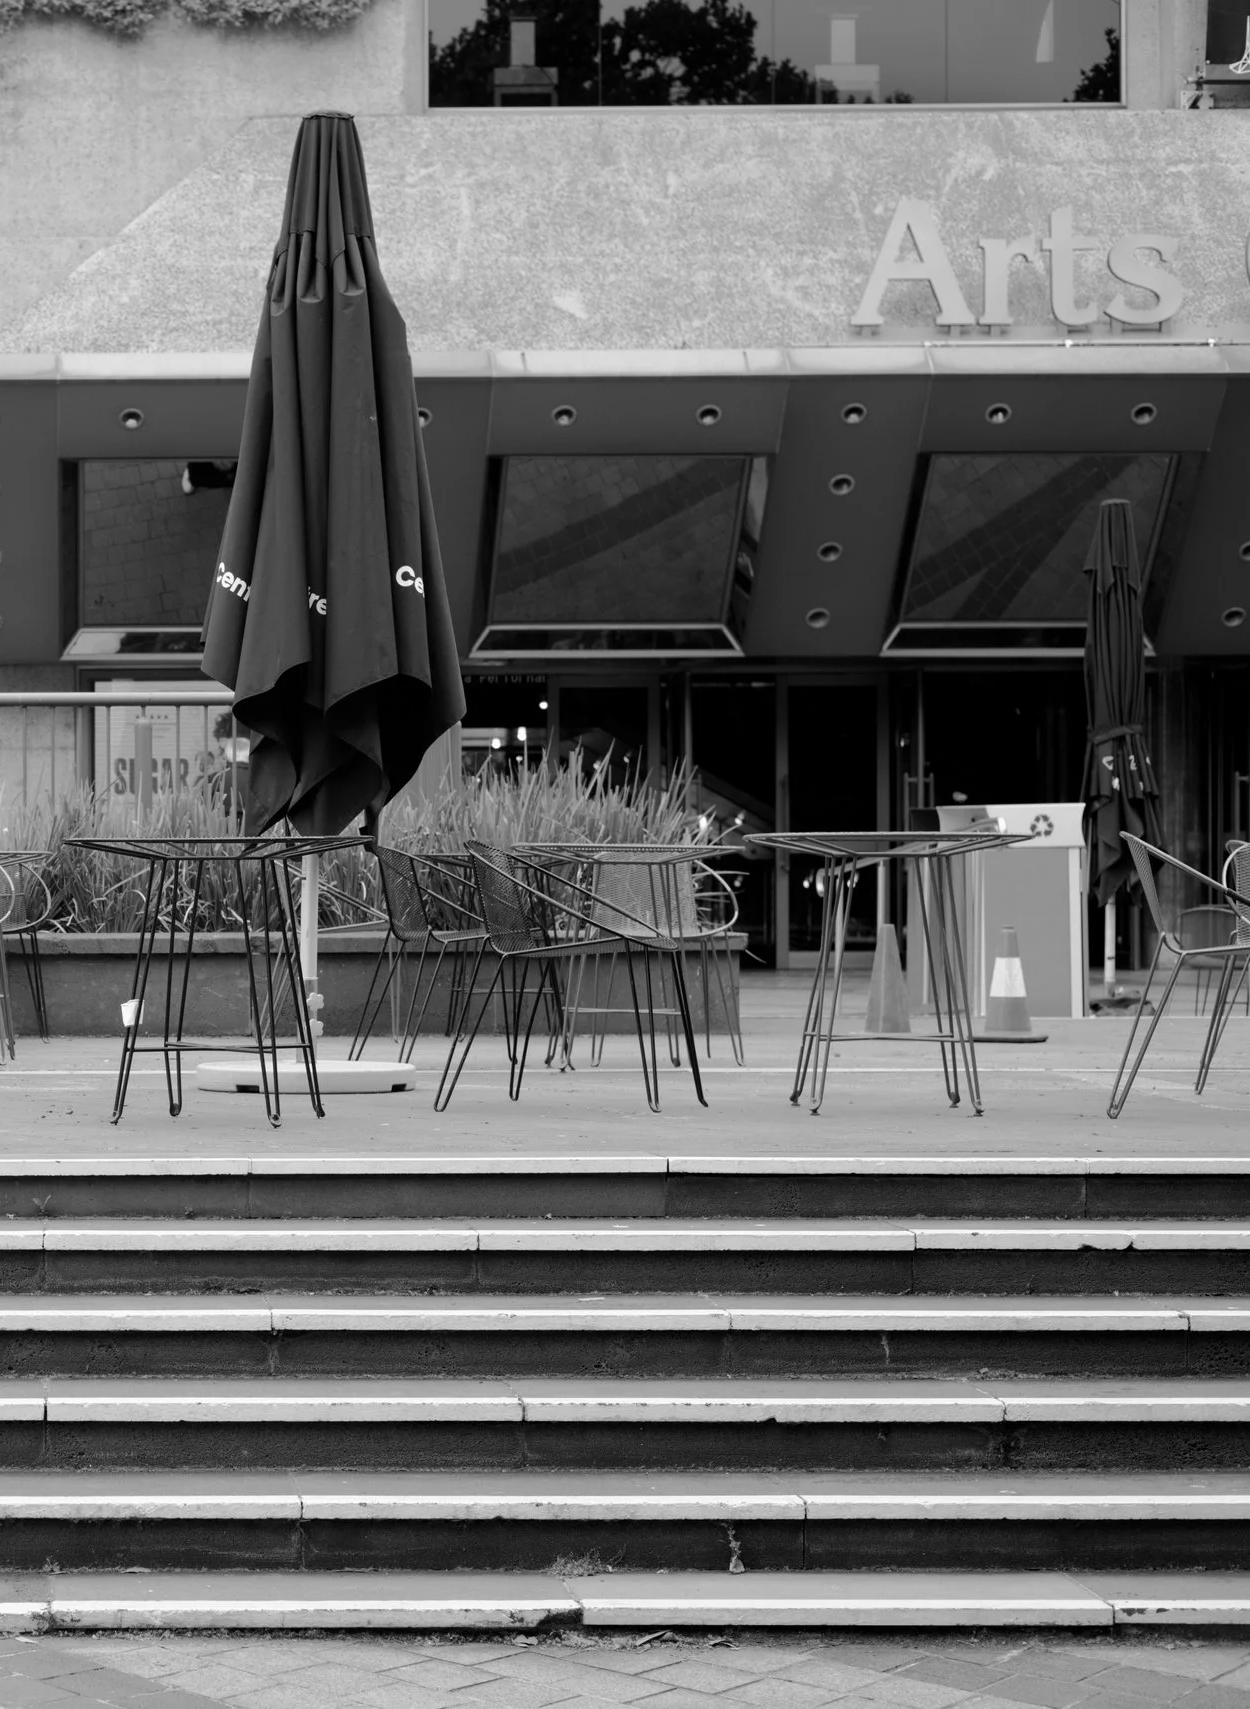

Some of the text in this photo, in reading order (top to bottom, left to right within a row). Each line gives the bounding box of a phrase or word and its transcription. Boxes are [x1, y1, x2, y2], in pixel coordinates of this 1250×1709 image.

[849, 197, 1184, 327] Arts
[395, 565, 425, 598] Ce
[308, 586, 327, 615] re
